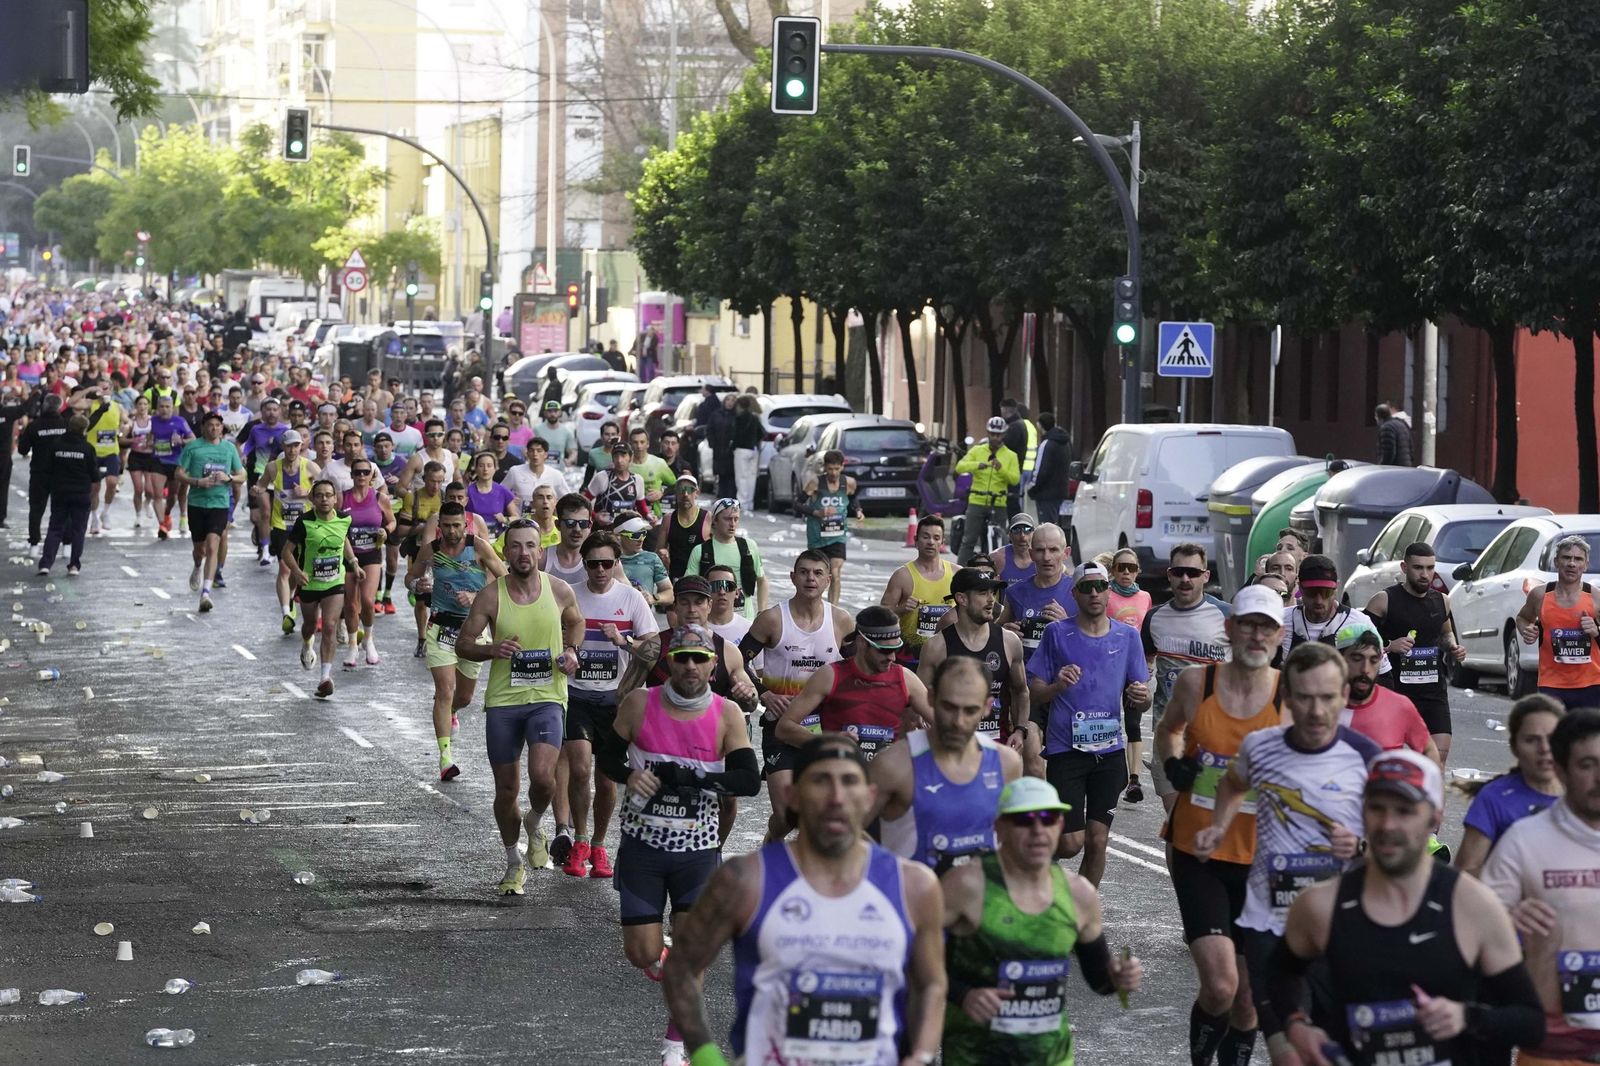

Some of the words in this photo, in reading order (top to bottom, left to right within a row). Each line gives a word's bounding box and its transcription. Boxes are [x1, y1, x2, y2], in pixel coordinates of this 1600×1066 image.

[346, 276, 363, 285] 30
[1558, 647, 1585, 656] JAVIER
[581, 670, 613, 679] DAMIEN
[860, 727, 889, 736] ZURICH
[1073, 734, 1090, 743] DEL
[652, 803, 687, 818] PABLO
[1290, 856, 1334, 868] ZURICH
[808, 1018, 862, 1041] FABIO
